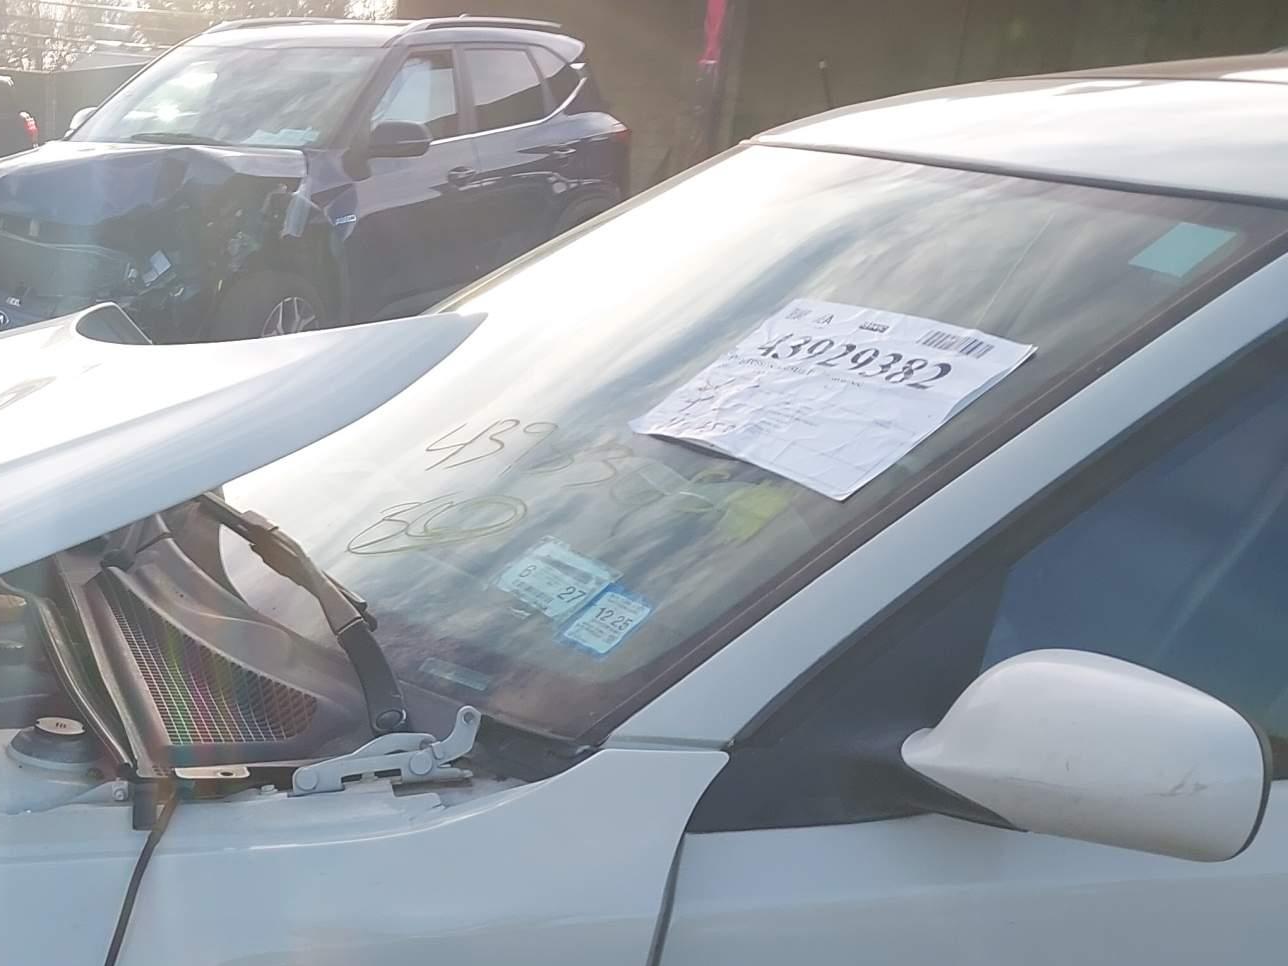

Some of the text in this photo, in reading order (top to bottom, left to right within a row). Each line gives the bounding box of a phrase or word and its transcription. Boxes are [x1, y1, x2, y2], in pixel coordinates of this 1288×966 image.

[757, 332, 953, 391] 43929382
[557, 585, 587, 604] 27
[594, 607, 634, 631] 12 25
